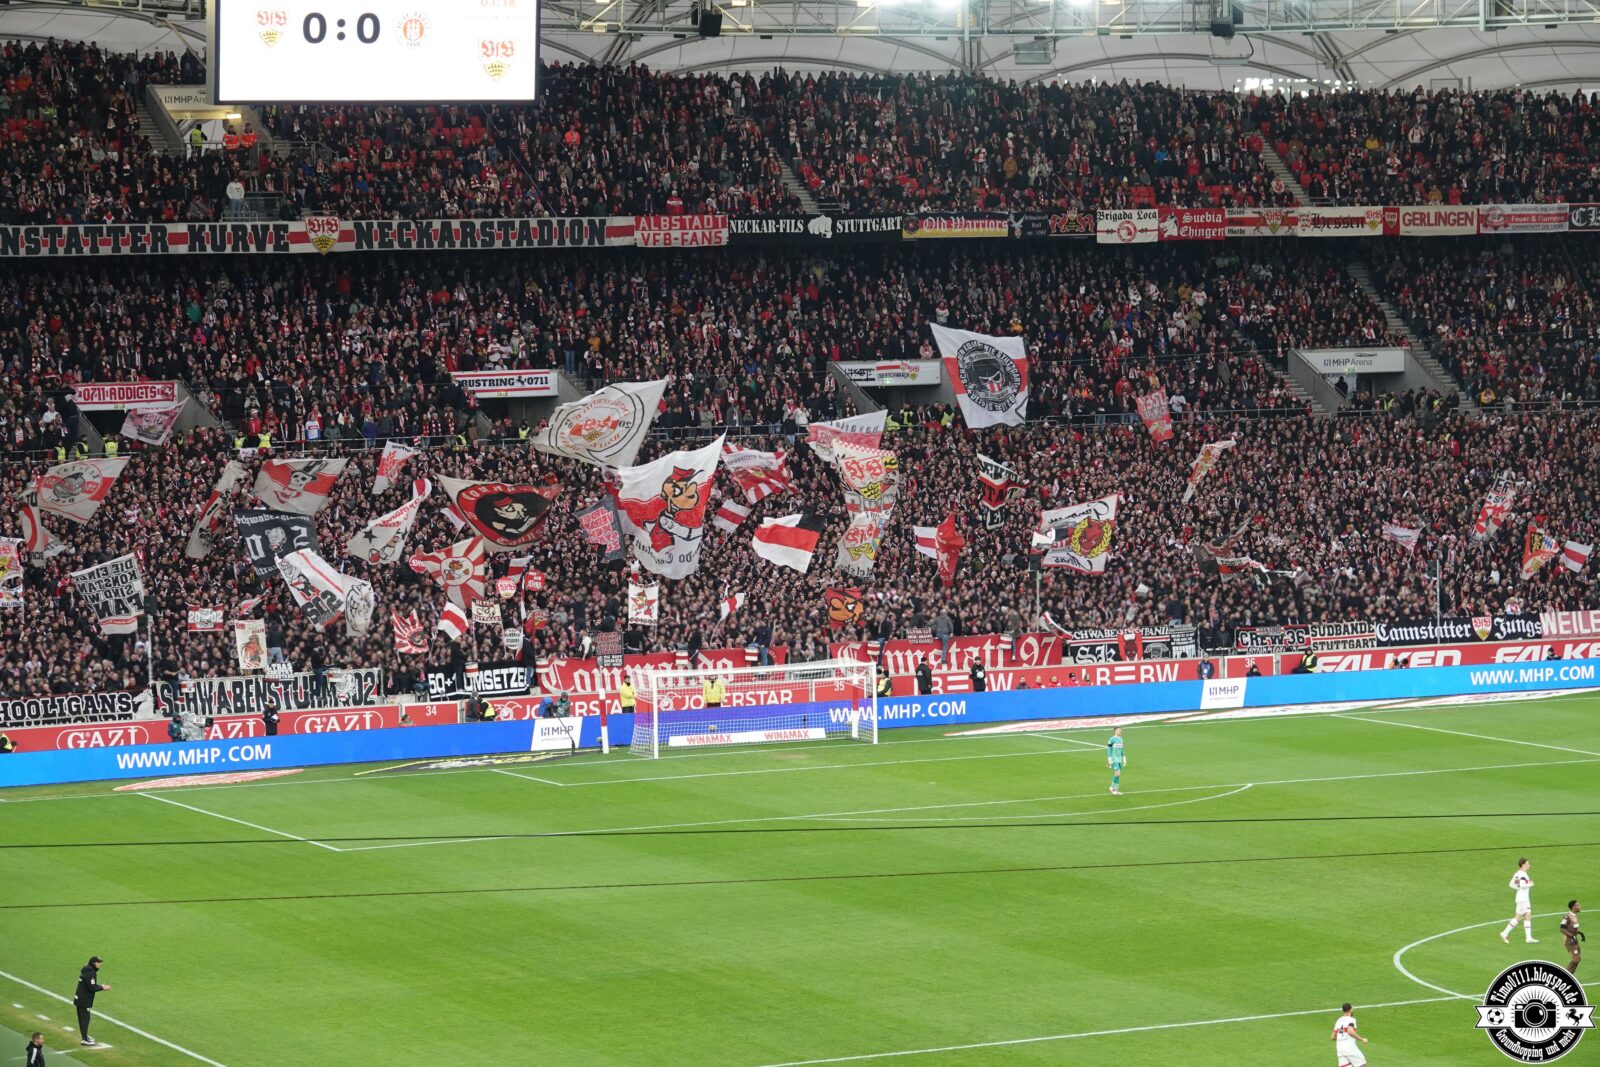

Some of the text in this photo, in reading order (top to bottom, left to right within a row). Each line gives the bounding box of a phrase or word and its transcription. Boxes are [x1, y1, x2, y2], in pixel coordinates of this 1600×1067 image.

[638, 214, 726, 231] ALBSTADT
[729, 216, 903, 234] NECKAR-FILS STUTTGART
[951, 214, 1009, 233] Warriors
[1097, 210, 1133, 222] Brigada
[1182, 212, 1223, 223] Suebia
[1402, 210, 1475, 228] GERLINGEN
[187, 223, 290, 254] KURVE
[353, 218, 607, 250] NECKARSTADION
[641, 230, 724, 246] VFB-FANS
[526, 376, 549, 385] 0711
[1376, 622, 1472, 643] Cannstatter
[1494, 617, 1542, 640] Jungs
[1312, 637, 1377, 651] STUTTGART
[837, 636, 1057, 677] Cnnstatt 97
[1470, 665, 1595, 686] WWW.MHP.COM
[159, 673, 348, 718] SHWABENSTURM
[1219, 685, 1239, 696] MHP
[680, 689, 793, 711] JOERSTAR
[425, 705, 438, 717] 34
[829, 700, 967, 723] WWW.MHP.COM
[208, 719, 260, 741] AZI
[551, 725, 574, 736] MHP
[687, 733, 733, 745] WINAMAX
[764, 729, 810, 741] WINAMAX
[116, 743, 272, 769] WWW.MHP.COM
